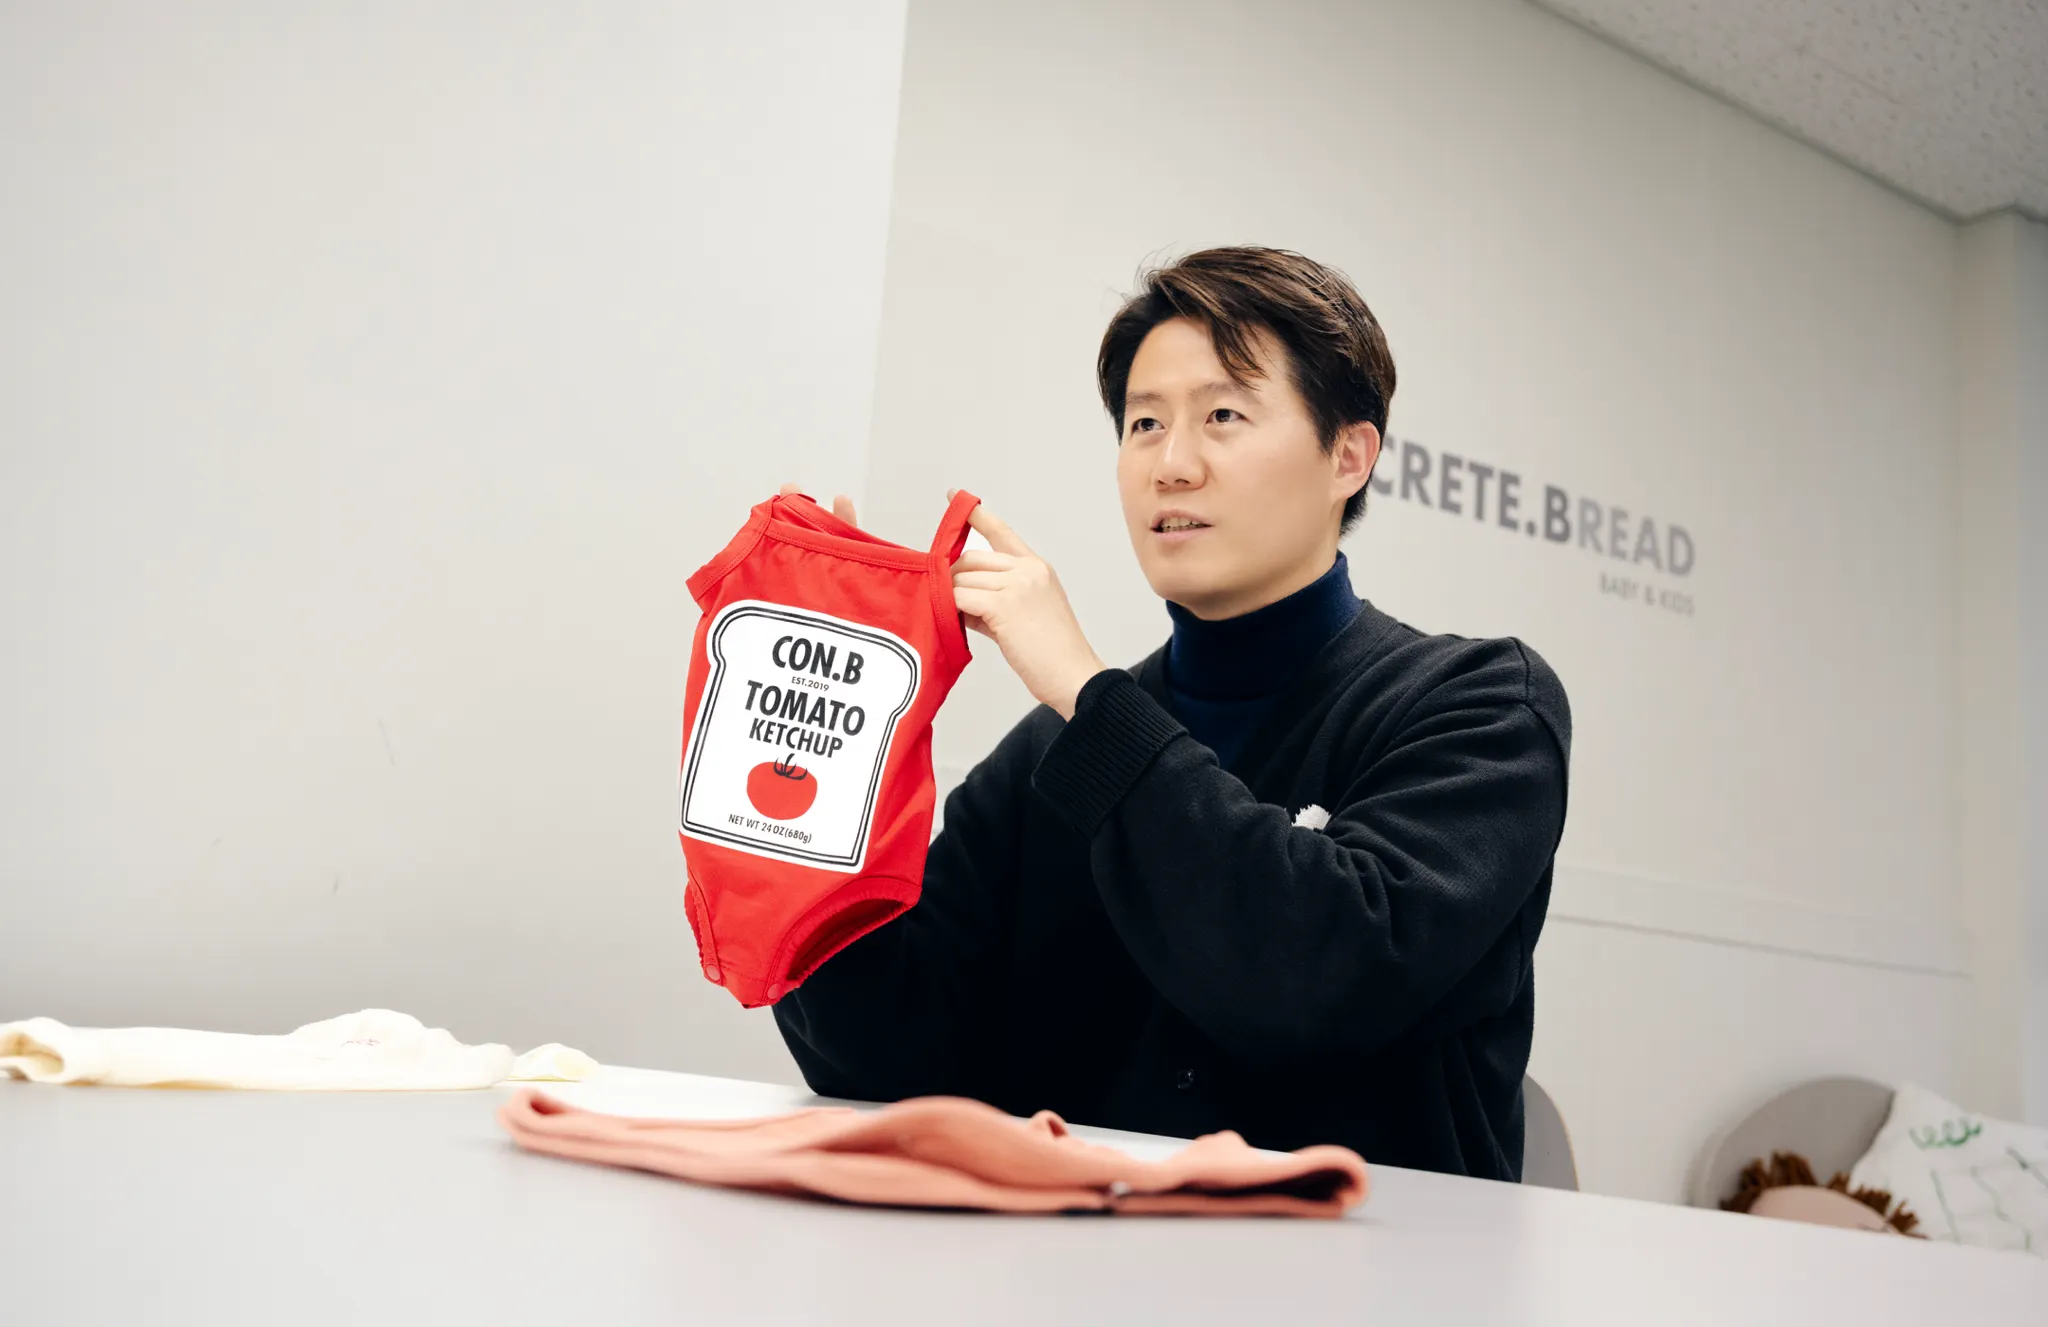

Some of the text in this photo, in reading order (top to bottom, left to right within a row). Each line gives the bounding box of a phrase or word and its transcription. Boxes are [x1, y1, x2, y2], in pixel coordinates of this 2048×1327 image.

[772, 635, 865, 685] CON.B
[791, 676, 829, 692] EST.2019
[745, 680, 865, 736] TOMATO
[749, 718, 843, 758] KETCHUP
[728, 814, 744, 825] NET
[746, 818, 760, 829] WT
